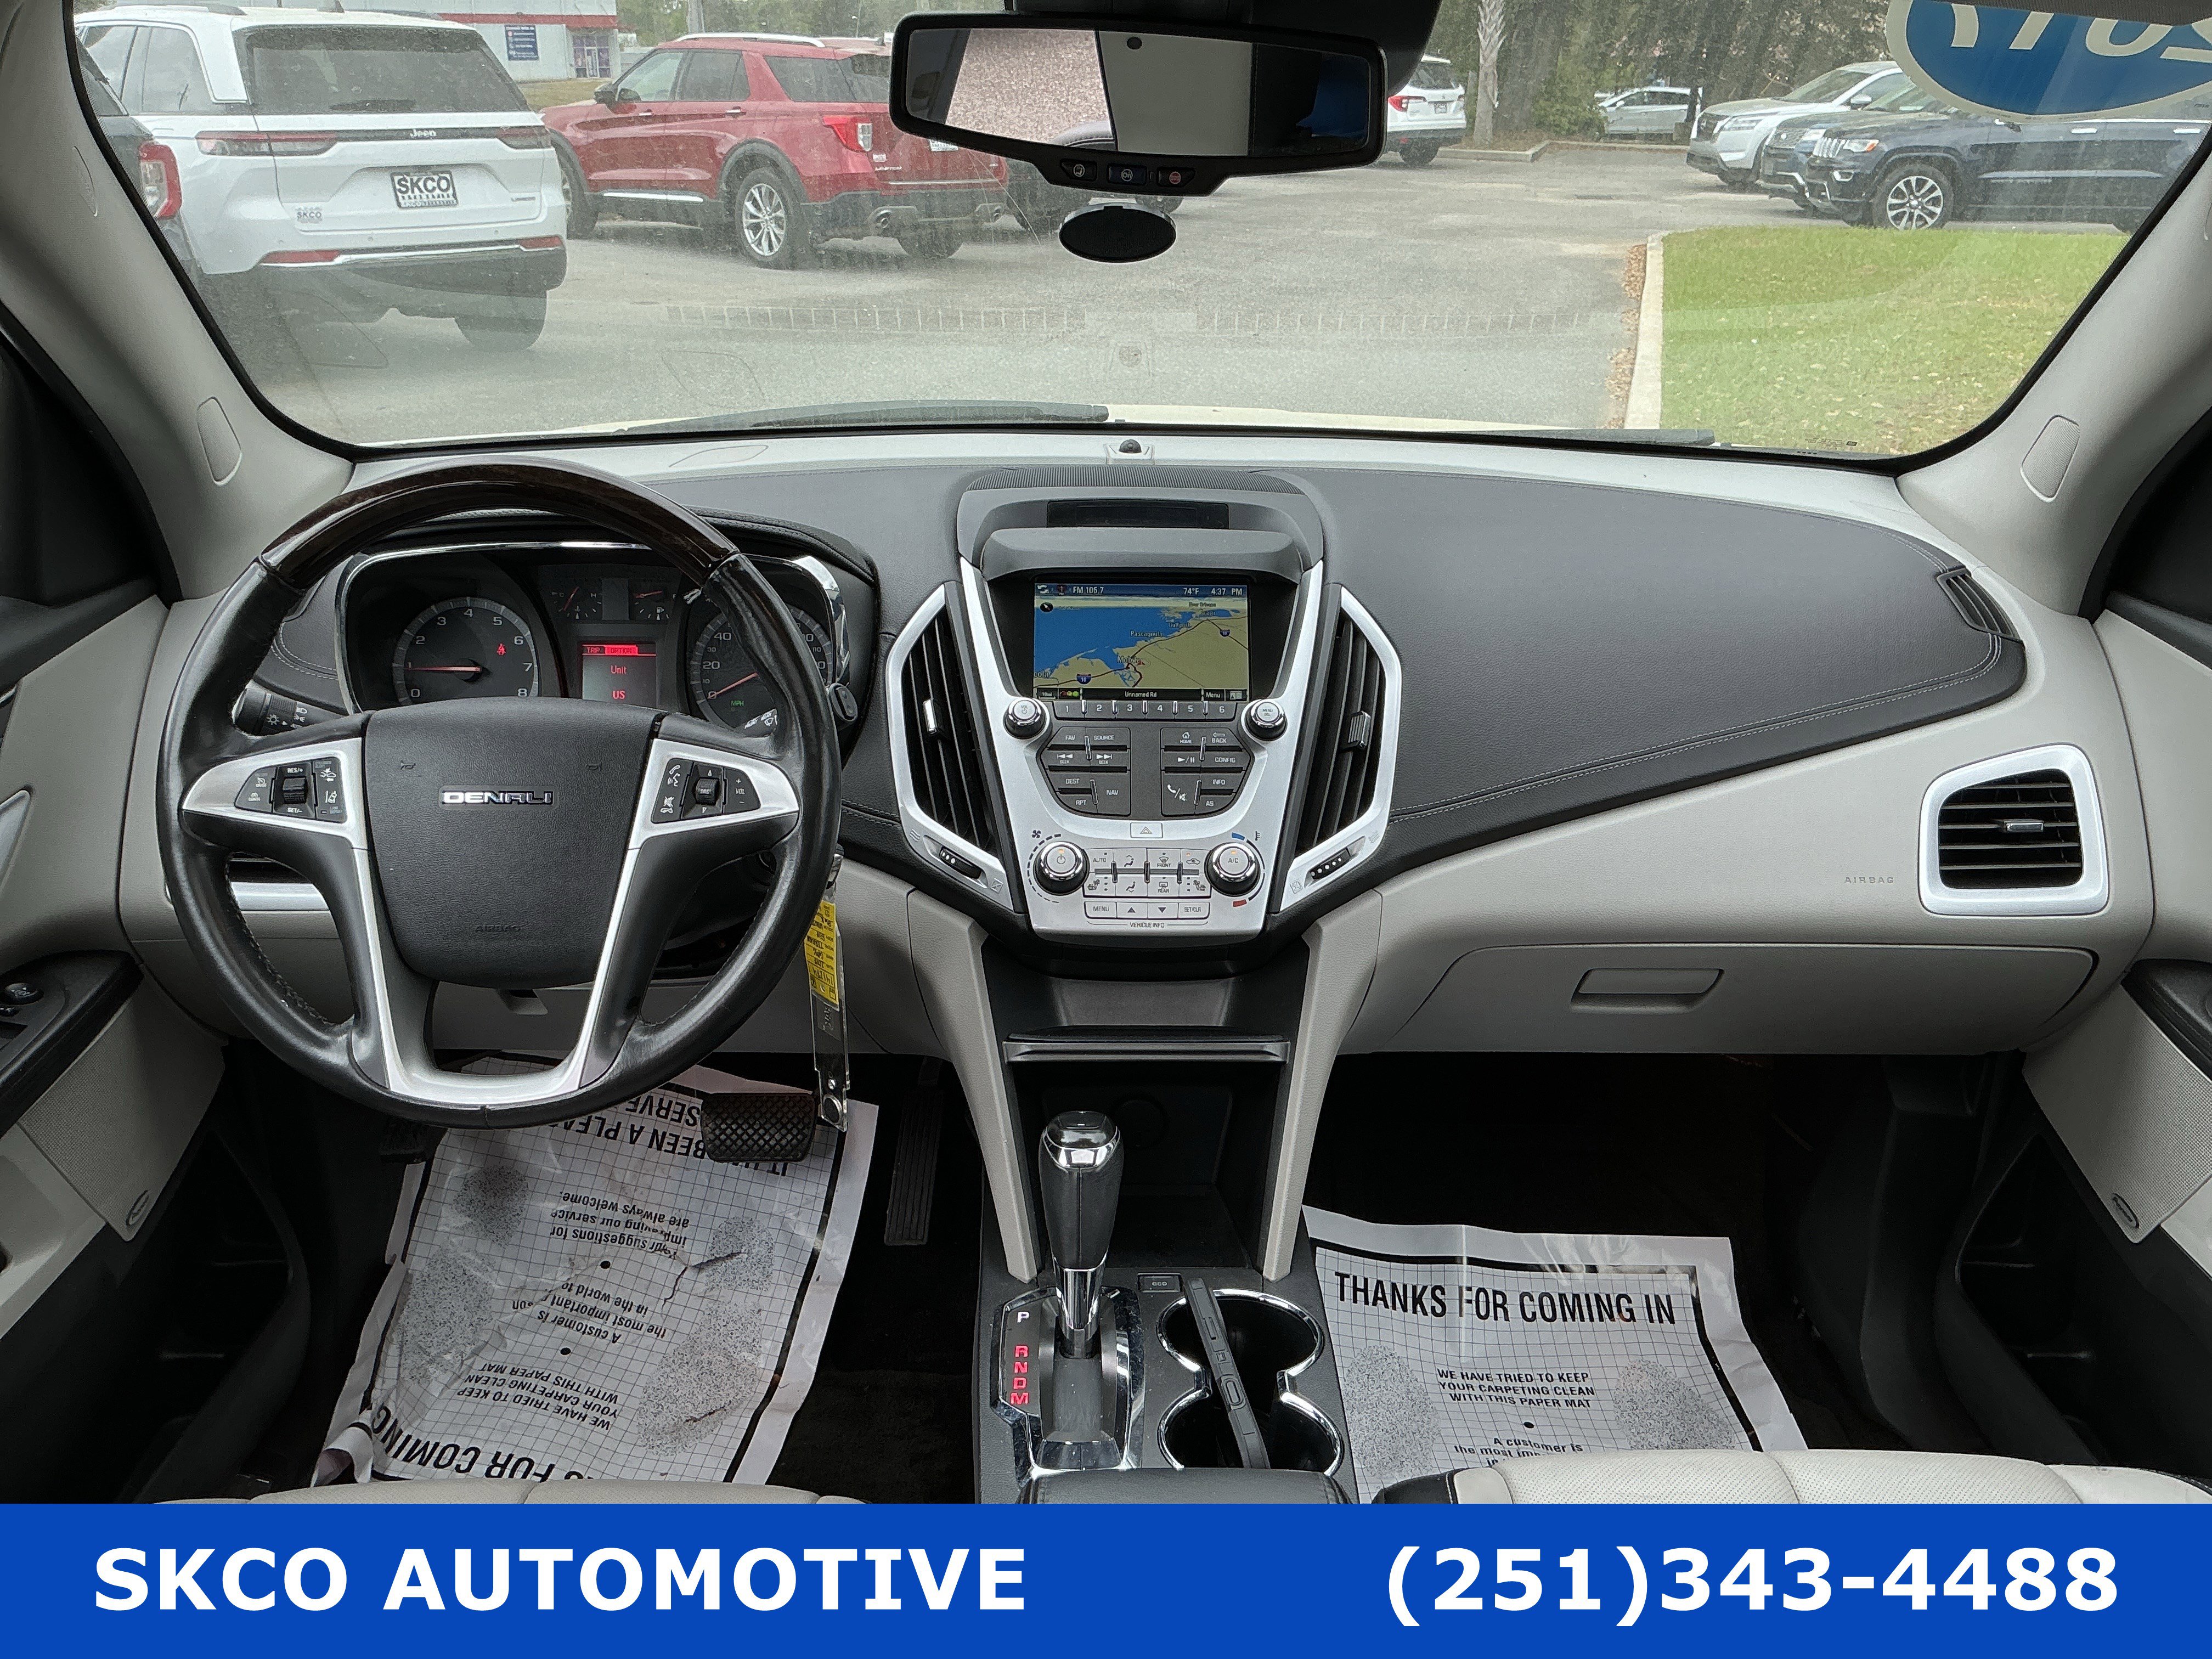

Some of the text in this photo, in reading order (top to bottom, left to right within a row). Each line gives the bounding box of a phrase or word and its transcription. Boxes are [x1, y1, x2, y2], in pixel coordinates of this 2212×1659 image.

[397, 176, 450, 194] SKCO
[464, 608, 473, 617] 4
[437, 617, 447, 625] 3
[493, 617, 503, 625] 5
[415, 636, 425, 645] 2
[514, 636, 524, 645] 6
[714, 632, 732, 641] 40
[523, 663, 533, 672] 7
[610, 665, 627, 674] Unit
[703, 661, 720, 669] 20
[410, 689, 421, 697] 0
[517, 688, 528, 697] 8
[612, 690, 626, 700] US
[708, 691, 717, 699] 0
[442, 791, 553, 805] DENALI
[475, 924, 521, 933] AIRBAG
[628, 1124, 645, 1145] A
[648, 1128, 706, 1159] BEEN
[550, 1209, 597, 1224] service
[559, 1192, 689, 1228] are always welcome.
[599, 1217, 621, 1227] our
[550, 1226, 568, 1240] for
[572, 1229, 647, 1249] suggestions
[561, 1283, 648, 1318] in the world to
[1334, 1271, 1675, 1325] THANKS FOR COMING IN
[550, 1295, 611, 1324] important
[612, 1314, 644, 1331] most
[1017, 1311, 1030, 1323] P
[537, 1310, 622, 1344] A customer is
[647, 1324, 667, 1339] the
[1015, 1345, 1029, 1358] R
[1014, 1362, 1028, 1374] N
[1437, 1368, 1589, 1383] WE HAVE TRIED TO KEEP
[478, 1363, 617, 1404] WITH THIS PAPER MAT
[1013, 1377, 1027, 1390] D
[1438, 1381, 1595, 1396] YOUR CARPETING CLEAN
[465, 1374, 618, 1418] YOUR CARPETING CLEAN
[1010, 1392, 1029, 1405] M
[1449, 1393, 1591, 1408] WITH THIS PAPER MAT
[457, 1387, 610, 1431] WE HAVE TRIED TO KEEP
[371, 1406, 555, 1483] FOR COMING
[1453, 1445, 1475, 1454] the
[1480, 1447, 1512, 1458] most
[1493, 1437, 1583, 1453] A customer is
